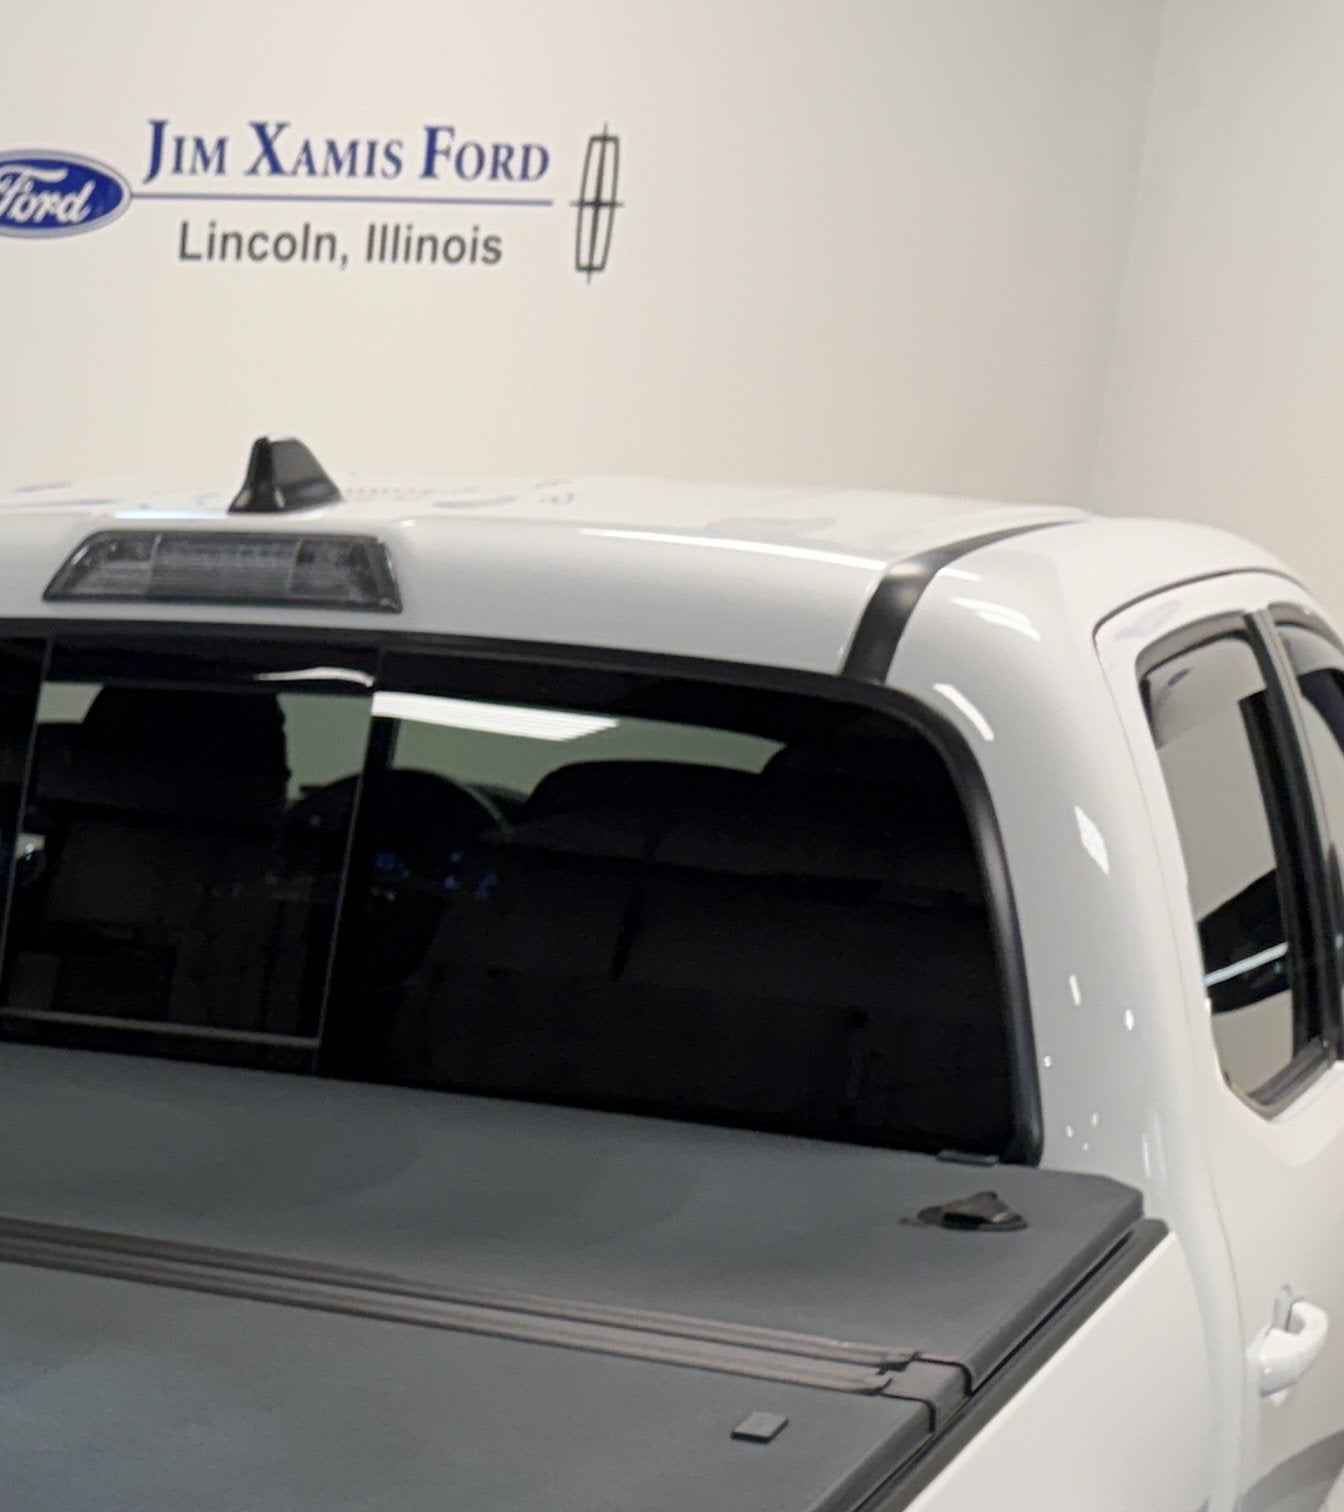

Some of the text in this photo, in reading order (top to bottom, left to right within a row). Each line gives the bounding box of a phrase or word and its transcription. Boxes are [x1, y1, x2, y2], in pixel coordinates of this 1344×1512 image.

[141, 119, 551, 186] JIM XAMIS FORD
[178, 221, 504, 271] Lincoln, Illinois
